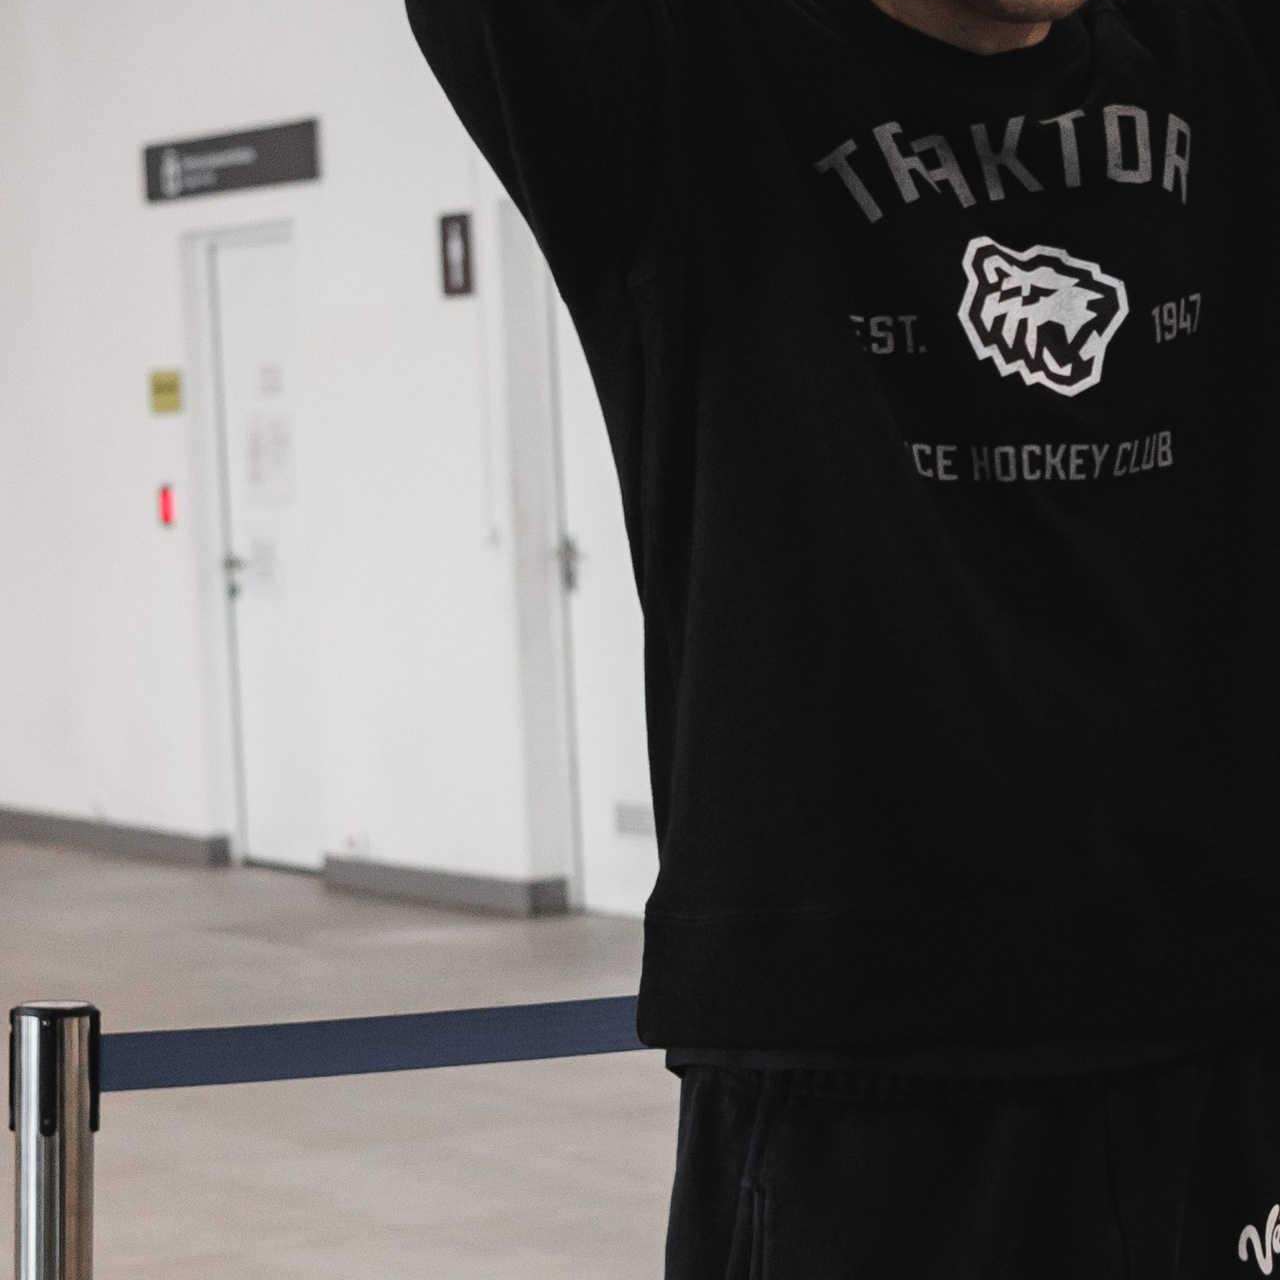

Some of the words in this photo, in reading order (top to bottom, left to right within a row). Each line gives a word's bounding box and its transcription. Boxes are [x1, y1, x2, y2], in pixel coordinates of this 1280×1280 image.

[1151, 292, 1201, 344] 1947
[904, 440, 959, 482] CE
[972, 443, 1110, 483] HOCKEY
[1112, 430, 1174, 477] CLUB
